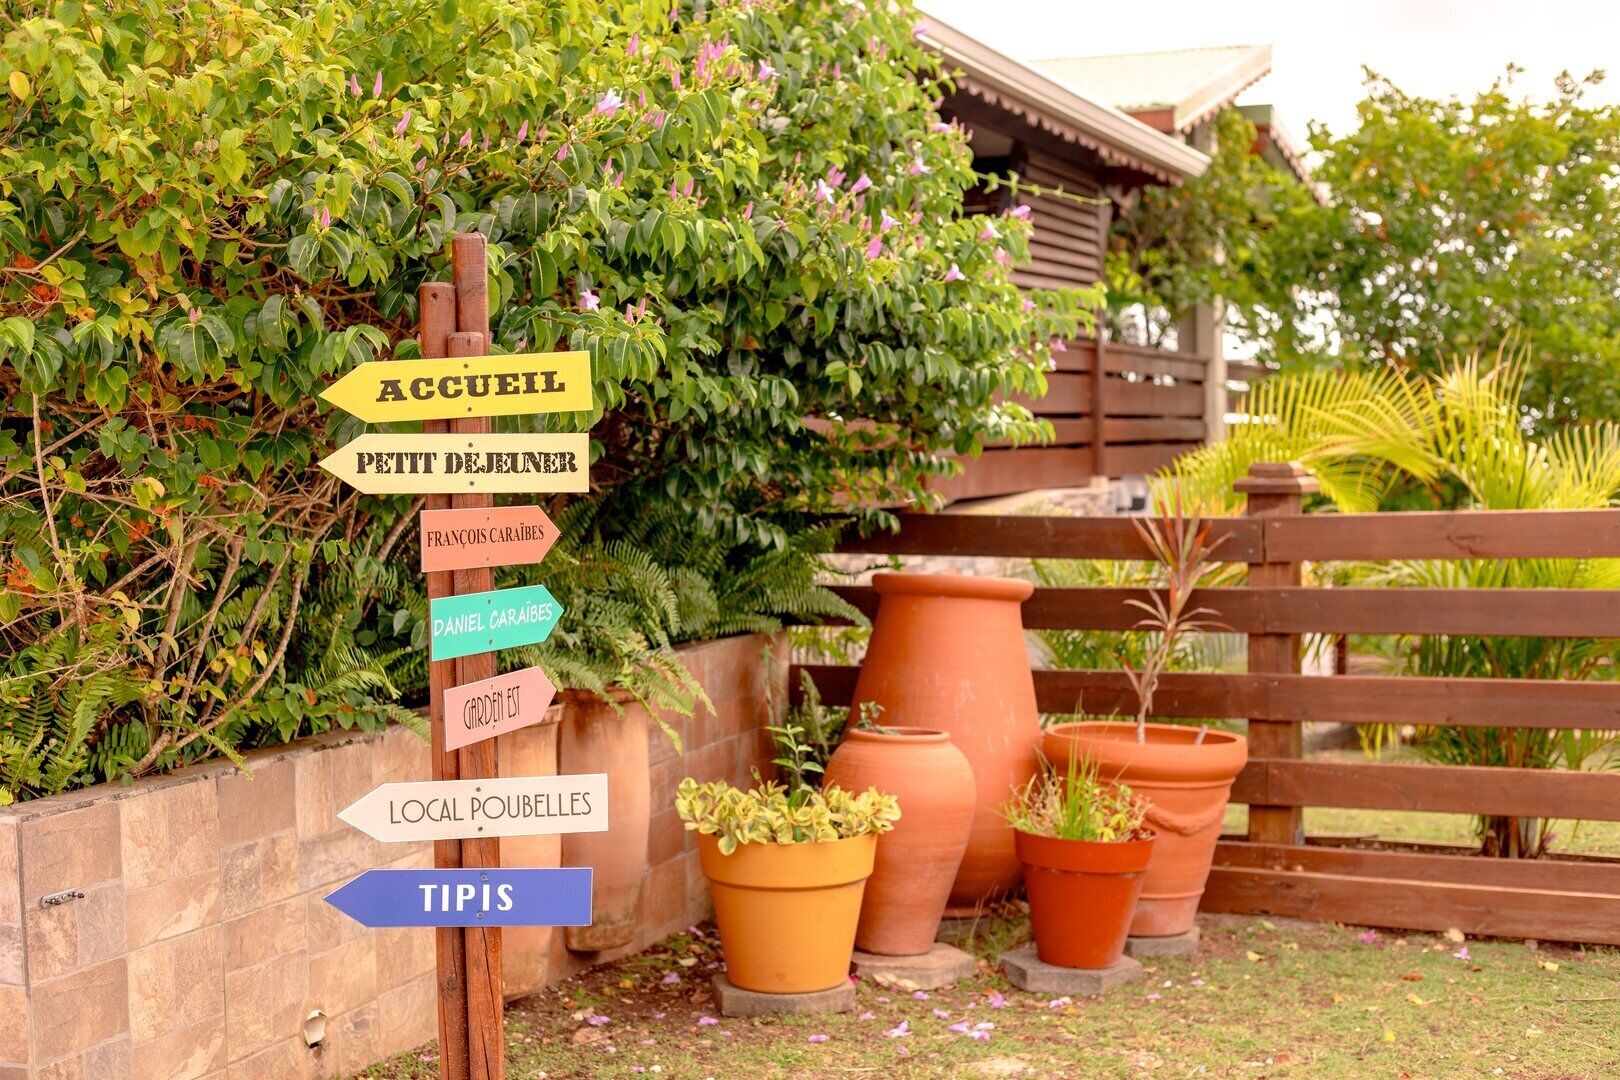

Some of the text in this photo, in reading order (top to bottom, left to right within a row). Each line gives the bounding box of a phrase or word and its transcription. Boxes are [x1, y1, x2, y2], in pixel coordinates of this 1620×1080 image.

[376, 371, 566, 402] ACCUEIL
[356, 452, 437, 474] PETIT
[427, 523, 545, 548] FRANÇOIS CARAÏBES
[434, 600, 553, 637] DANIEL CARAÏBES
[463, 686, 520, 730] GARDEN EST
[390, 792, 592, 824] LOCAL POUBELLES
[418, 883, 514, 912] TIPIS
